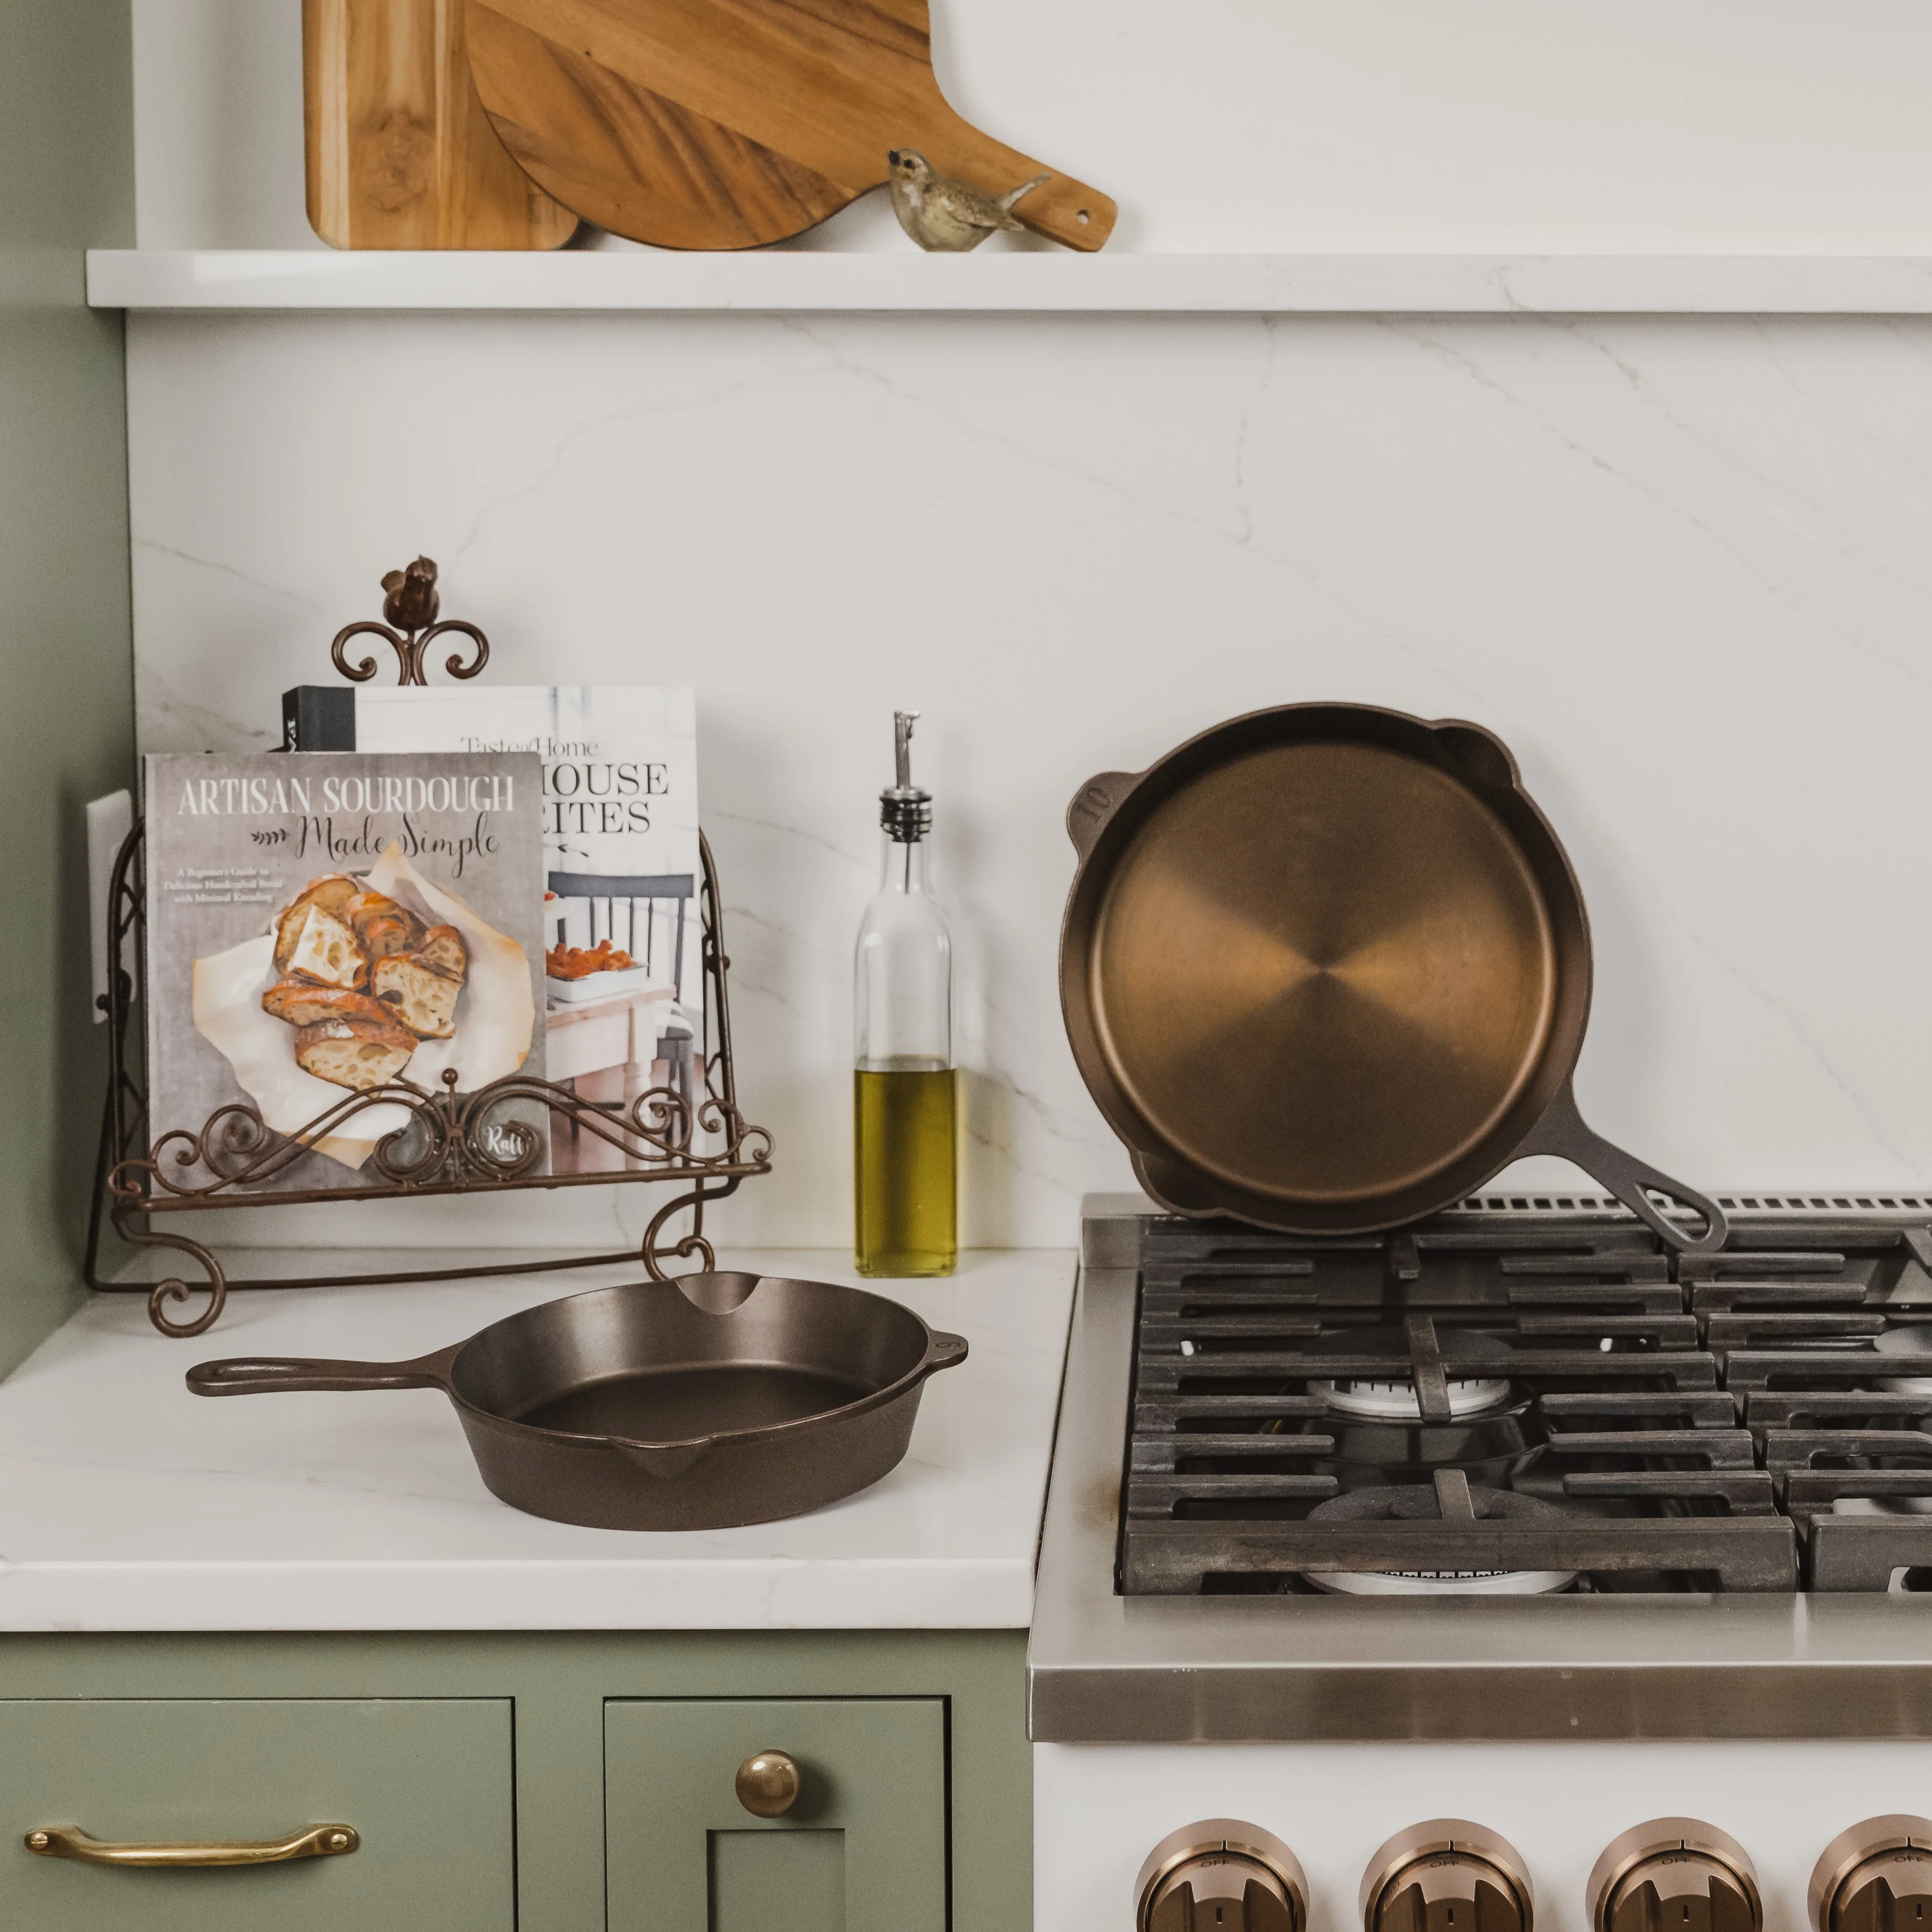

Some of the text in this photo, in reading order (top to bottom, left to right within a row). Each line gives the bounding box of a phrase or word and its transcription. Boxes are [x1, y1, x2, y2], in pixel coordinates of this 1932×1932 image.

[460, 738, 519, 752] Taste
[536, 737, 598, 756] Home
[178, 775, 514, 815] ARTISAN SOURDOUGH
[1078, 787, 1111, 822] 10
[543, 801, 650, 834] ITES
[295, 810, 500, 879] Made Simple
[1200, 1859, 1230, 1868] OFF
[1429, 1859, 1459, 1868] OFF
[1661, 1856, 1691, 1865] OFF
[1894, 1854, 1924, 1863] OFF
